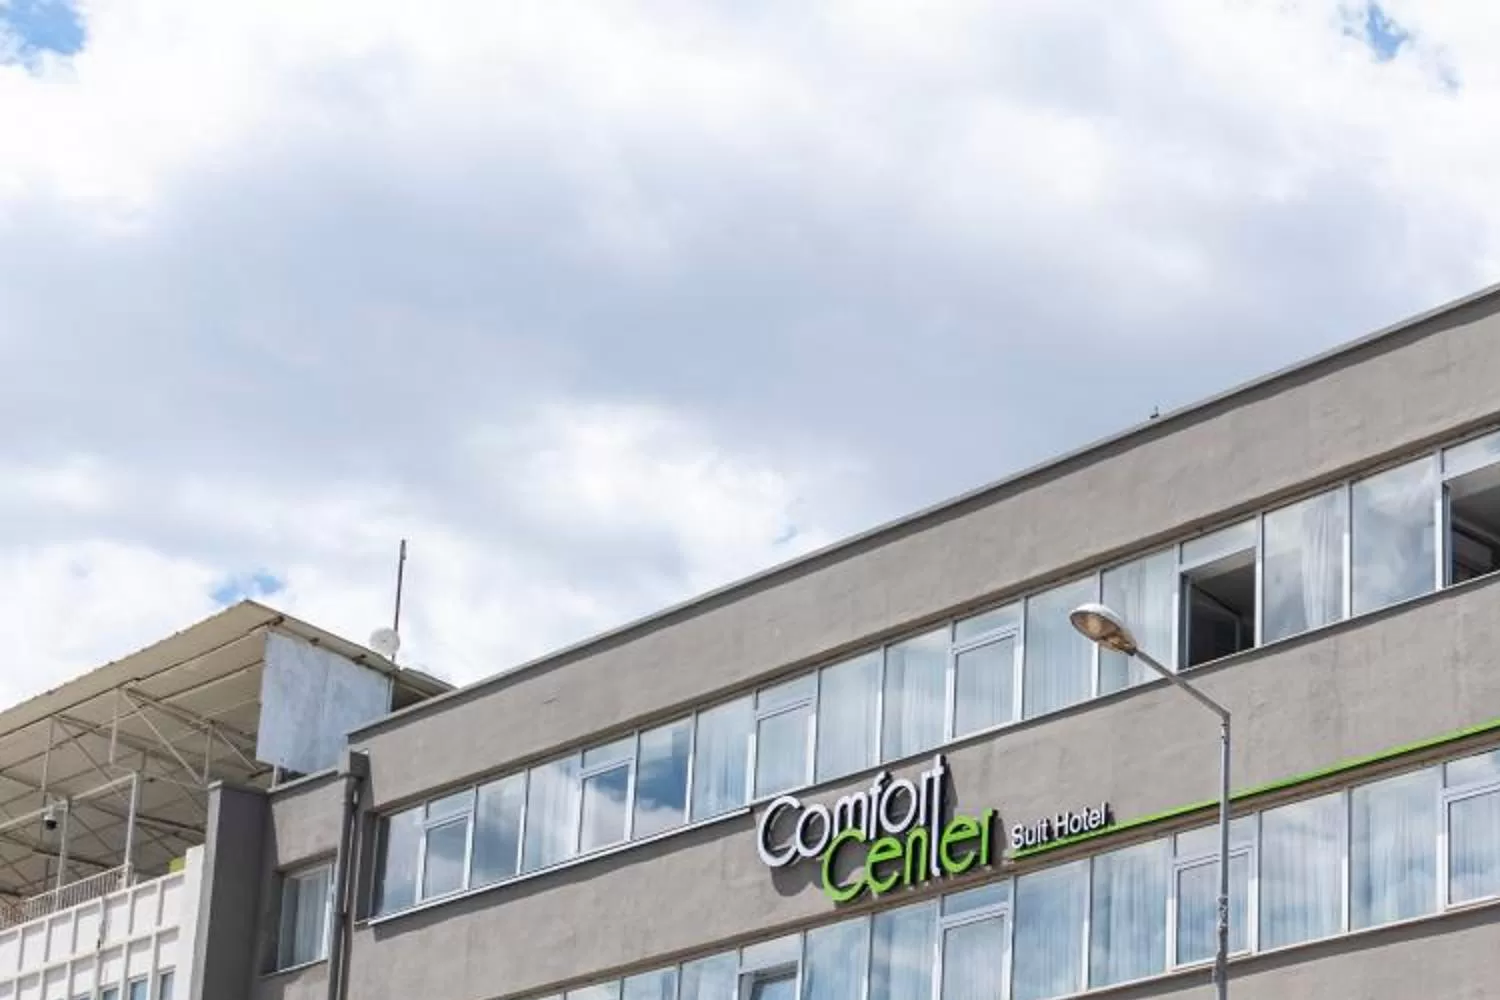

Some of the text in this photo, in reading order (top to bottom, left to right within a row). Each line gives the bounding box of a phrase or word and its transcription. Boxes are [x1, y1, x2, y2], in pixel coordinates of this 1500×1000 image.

[757, 753, 947, 876] Comfort
[821, 808, 994, 902] Center
[1011, 802, 1107, 850] Suit Hotel
